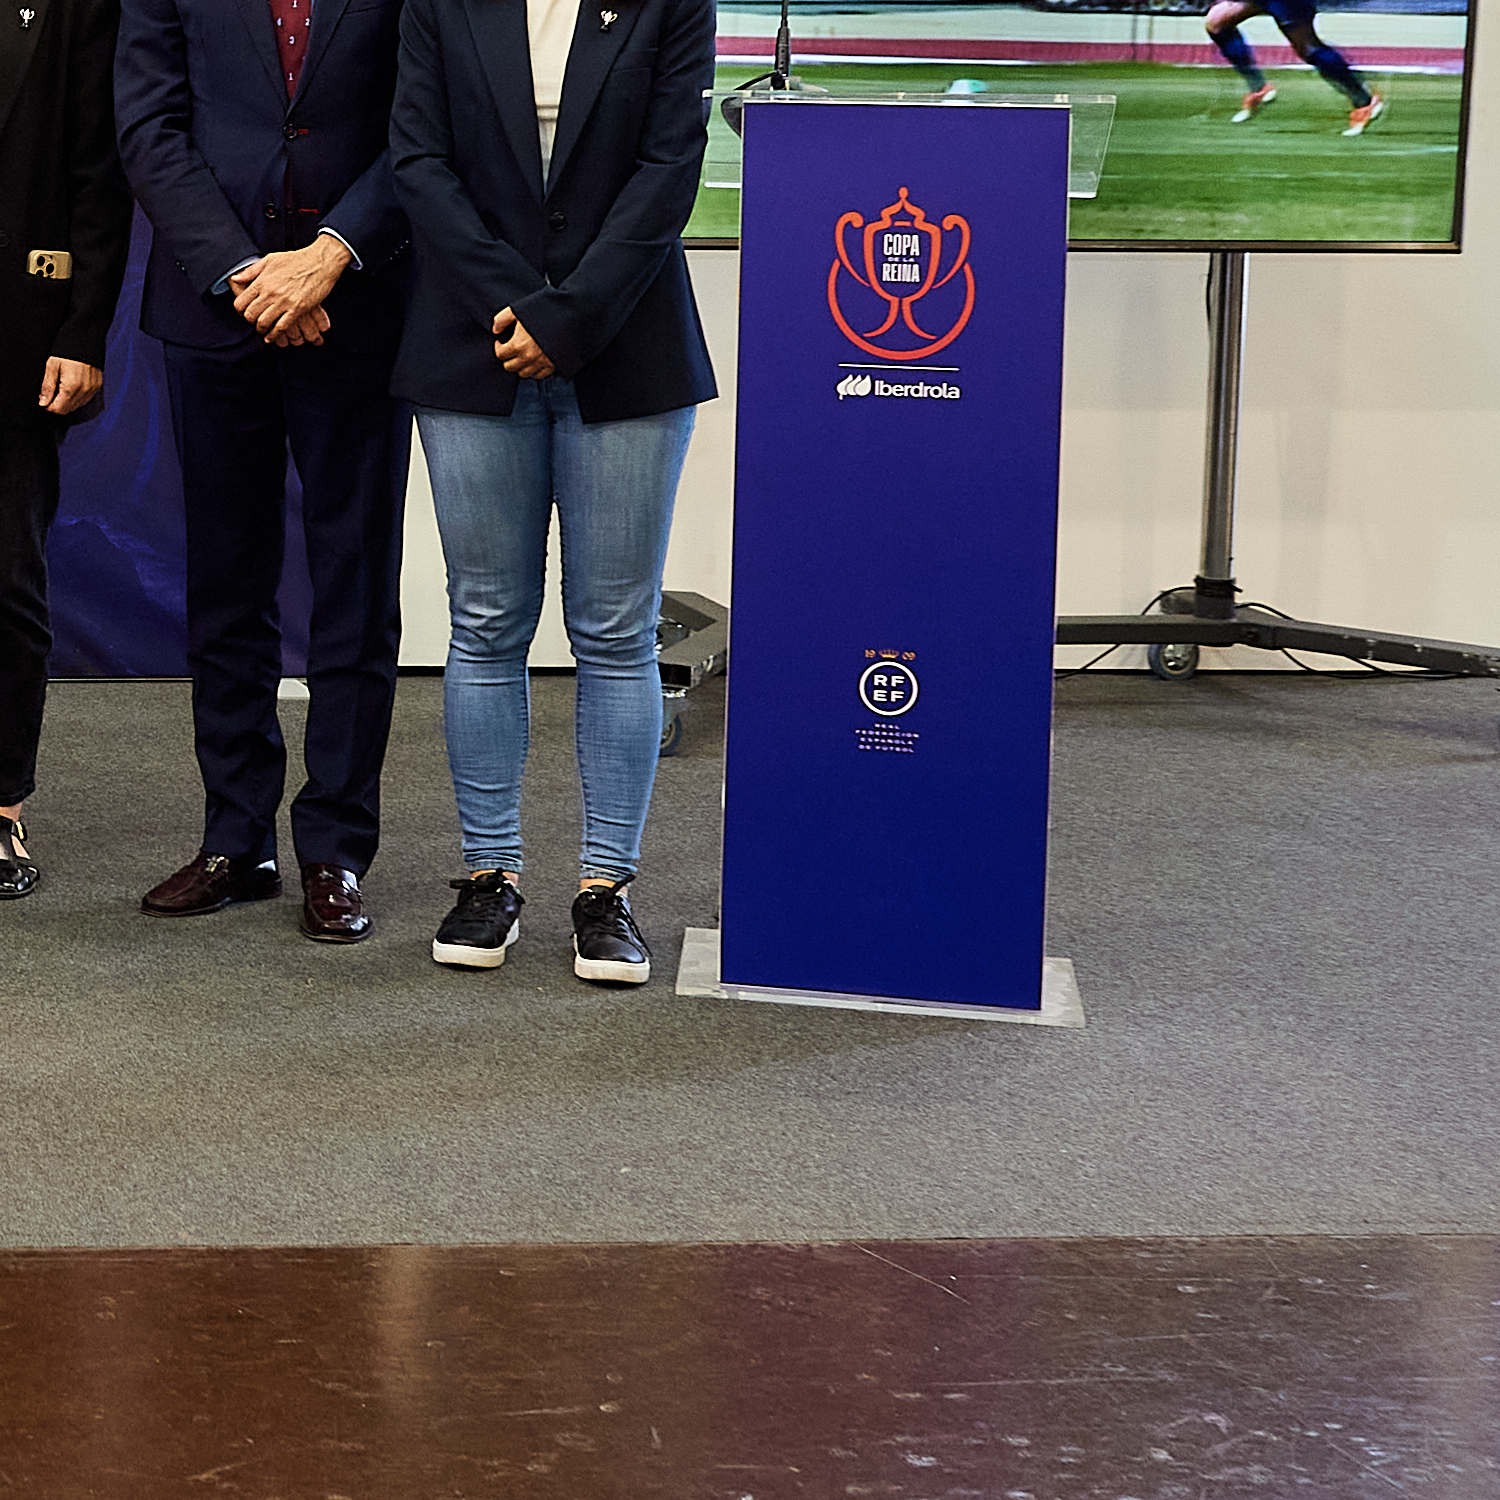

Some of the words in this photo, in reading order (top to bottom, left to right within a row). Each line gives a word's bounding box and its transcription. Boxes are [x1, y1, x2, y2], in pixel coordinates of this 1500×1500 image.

[883, 233, 920, 257] COPA
[882, 263, 920, 283] REINA
[874, 380, 961, 399] Iberdrola
